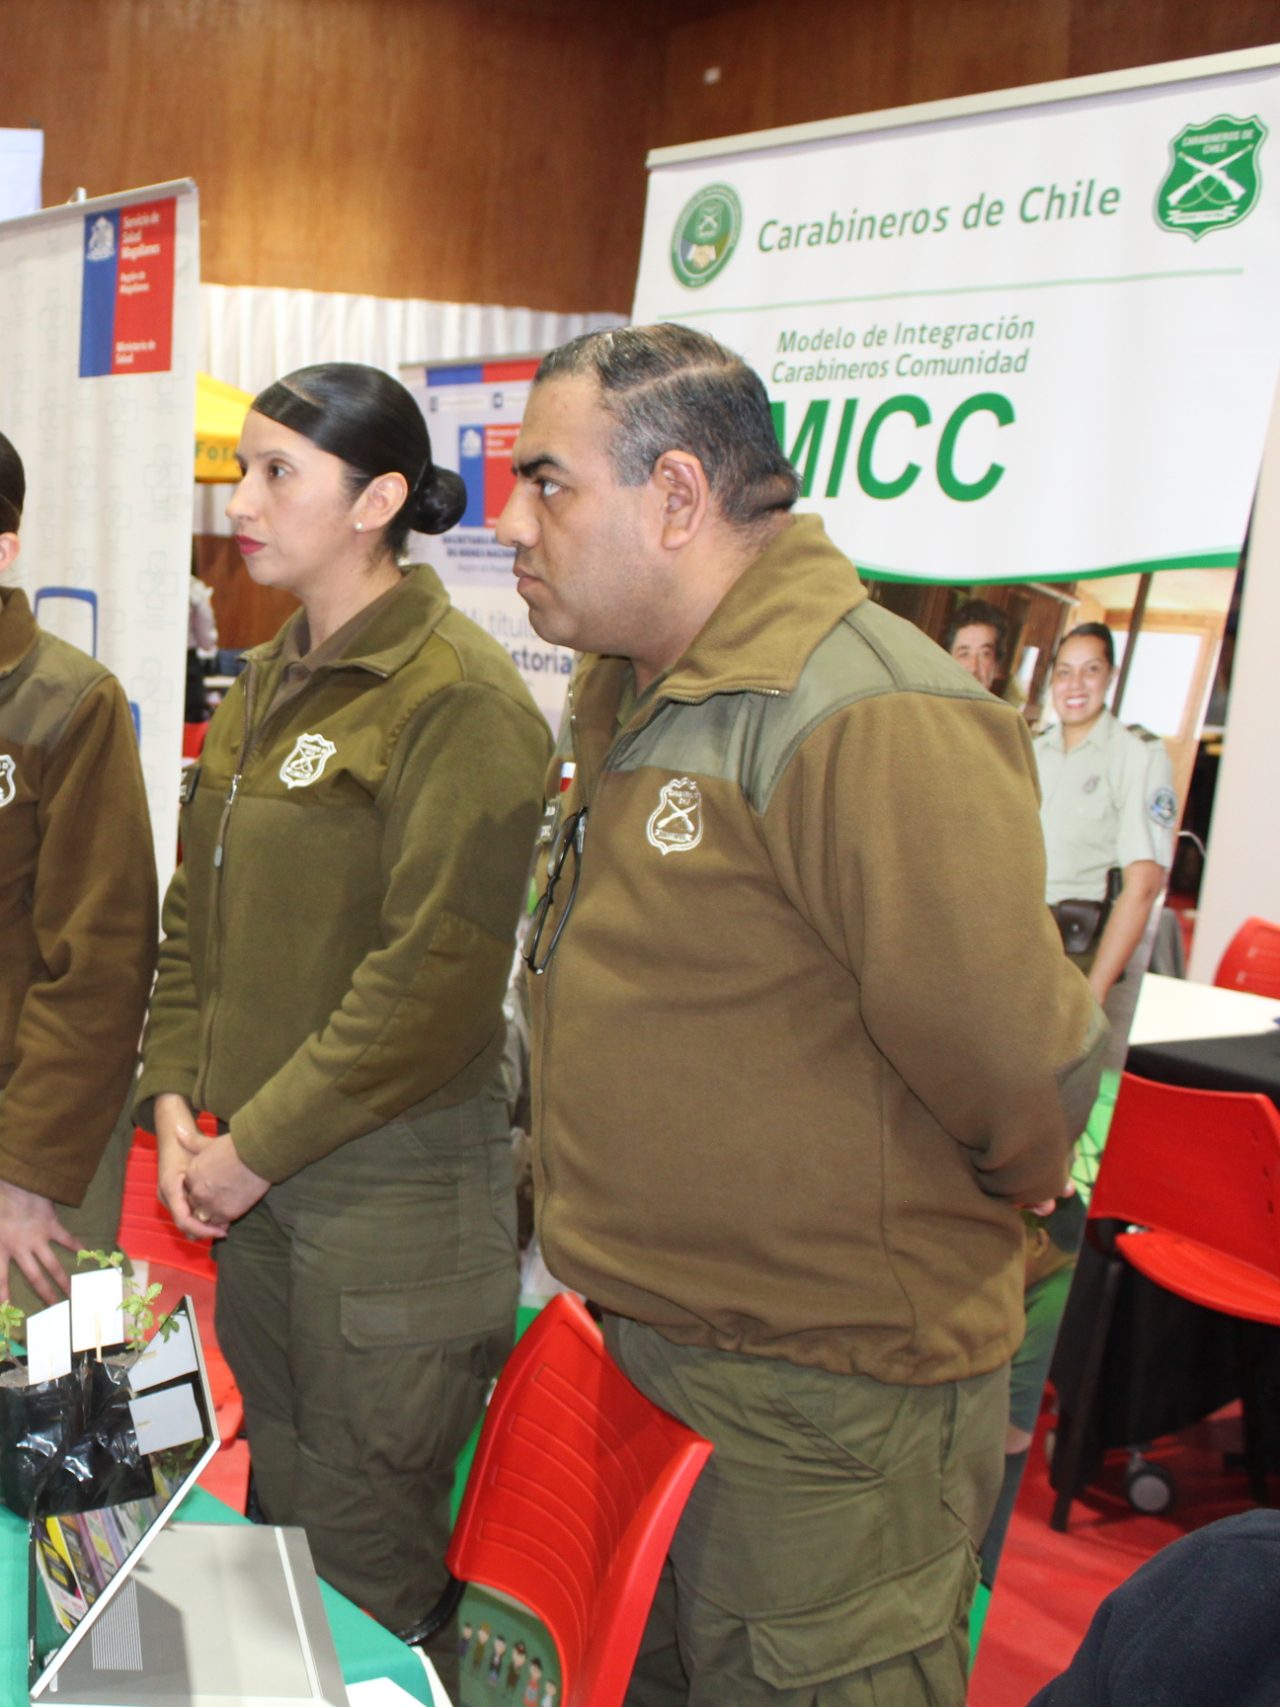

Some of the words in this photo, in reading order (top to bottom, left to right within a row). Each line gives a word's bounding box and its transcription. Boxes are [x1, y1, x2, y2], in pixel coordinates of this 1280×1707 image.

[757, 205, 948, 254] Carabineros
[961, 190, 1004, 230] de
[1019, 178, 1122, 225] Chile
[776, 326, 856, 353] Modelo
[862, 322, 888, 348] de
[892, 315, 1036, 350] Integración
[771, 356, 890, 384] Carabineros
[894, 347, 1030, 378] Comunidad
[771, 392, 1015, 503] MICC
